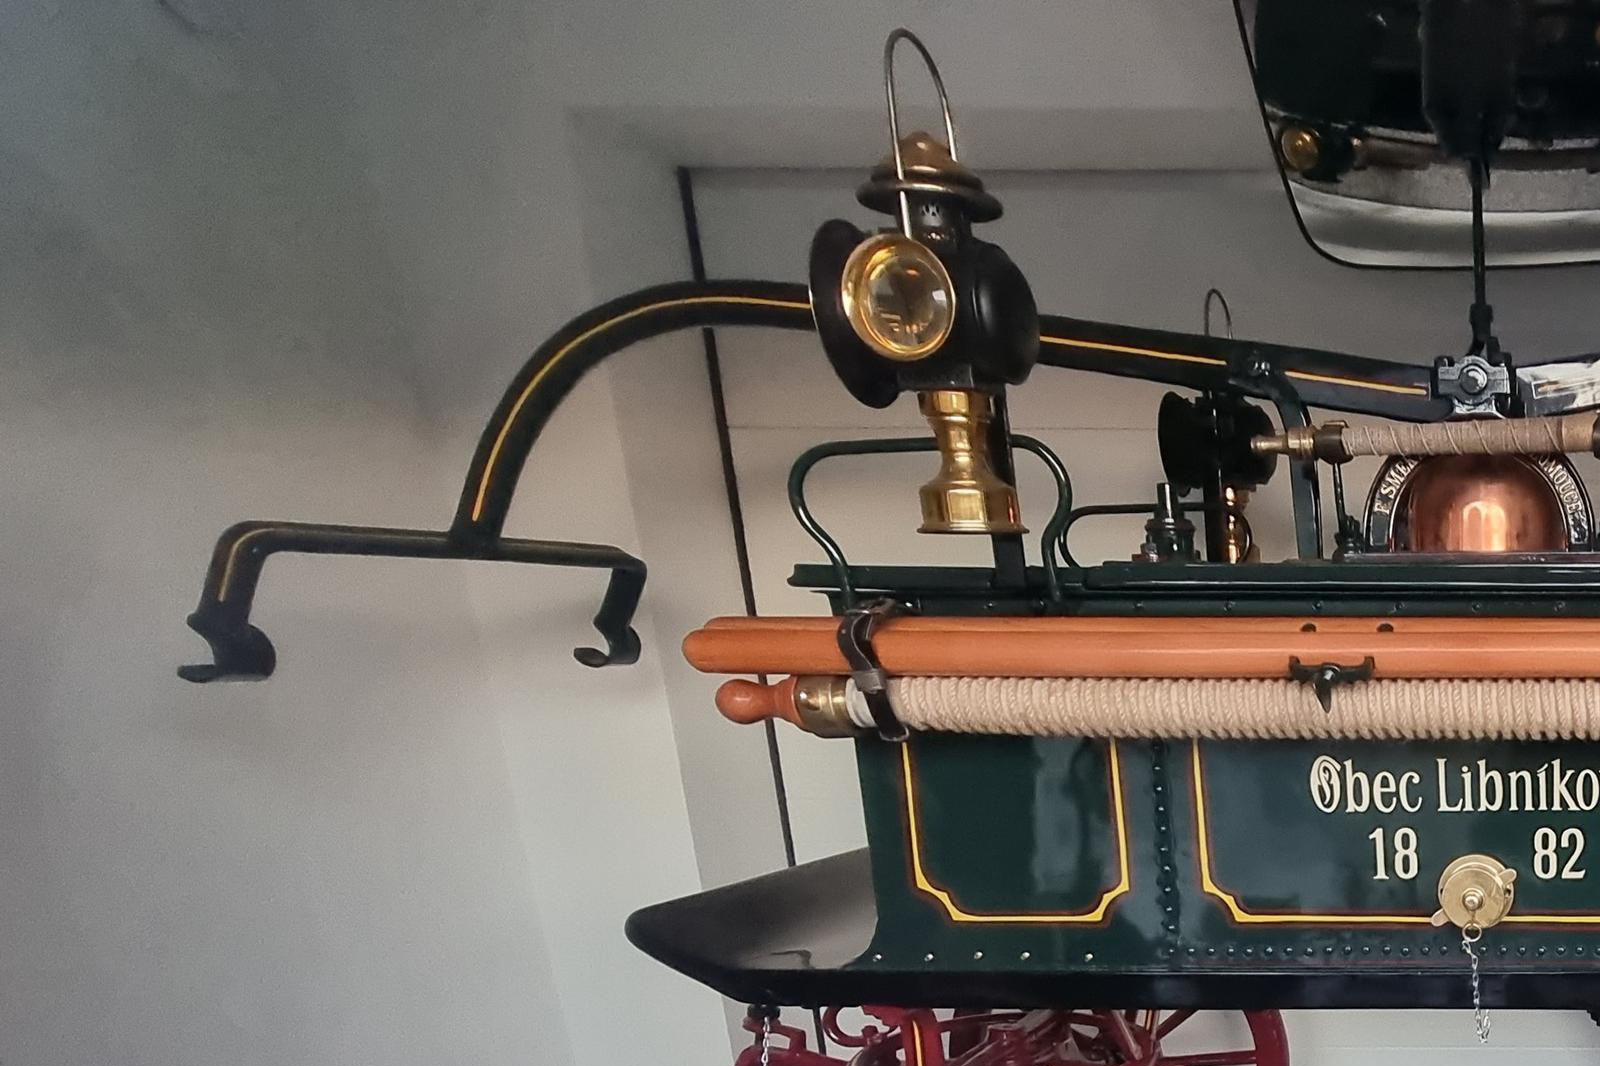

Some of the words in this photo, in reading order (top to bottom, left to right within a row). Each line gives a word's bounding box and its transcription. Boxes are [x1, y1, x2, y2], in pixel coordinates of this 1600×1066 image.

[1310, 755, 1422, 813] Obec
[1368, 827, 1419, 880] 18
[1533, 827, 1586, 880] 82
